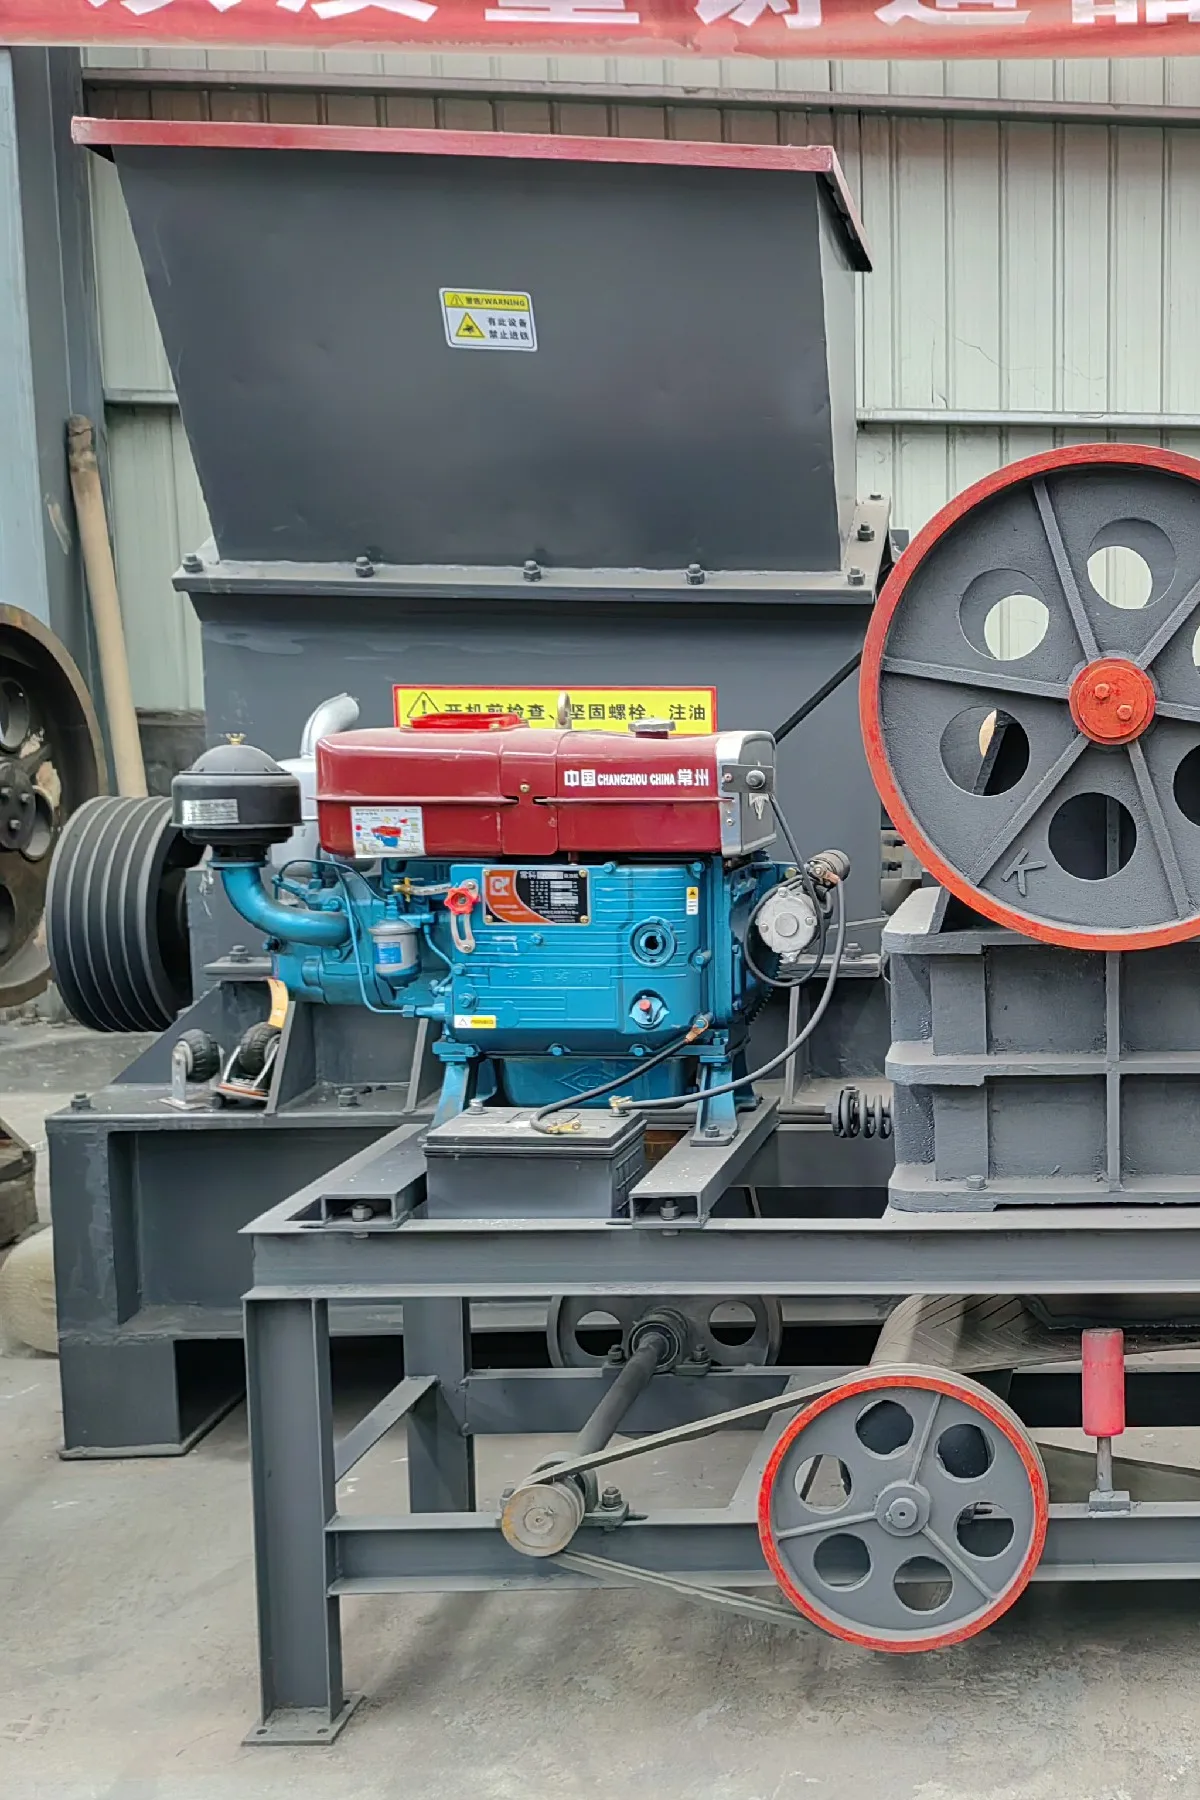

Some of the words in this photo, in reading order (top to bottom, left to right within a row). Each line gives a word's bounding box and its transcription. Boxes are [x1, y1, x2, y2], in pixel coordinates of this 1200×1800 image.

[564, 769, 596, 787] 中国
[597, 773, 648, 786] CHANGZHOU
[649, 773, 676, 786] CHINA
[677, 768, 709, 786] 常州
